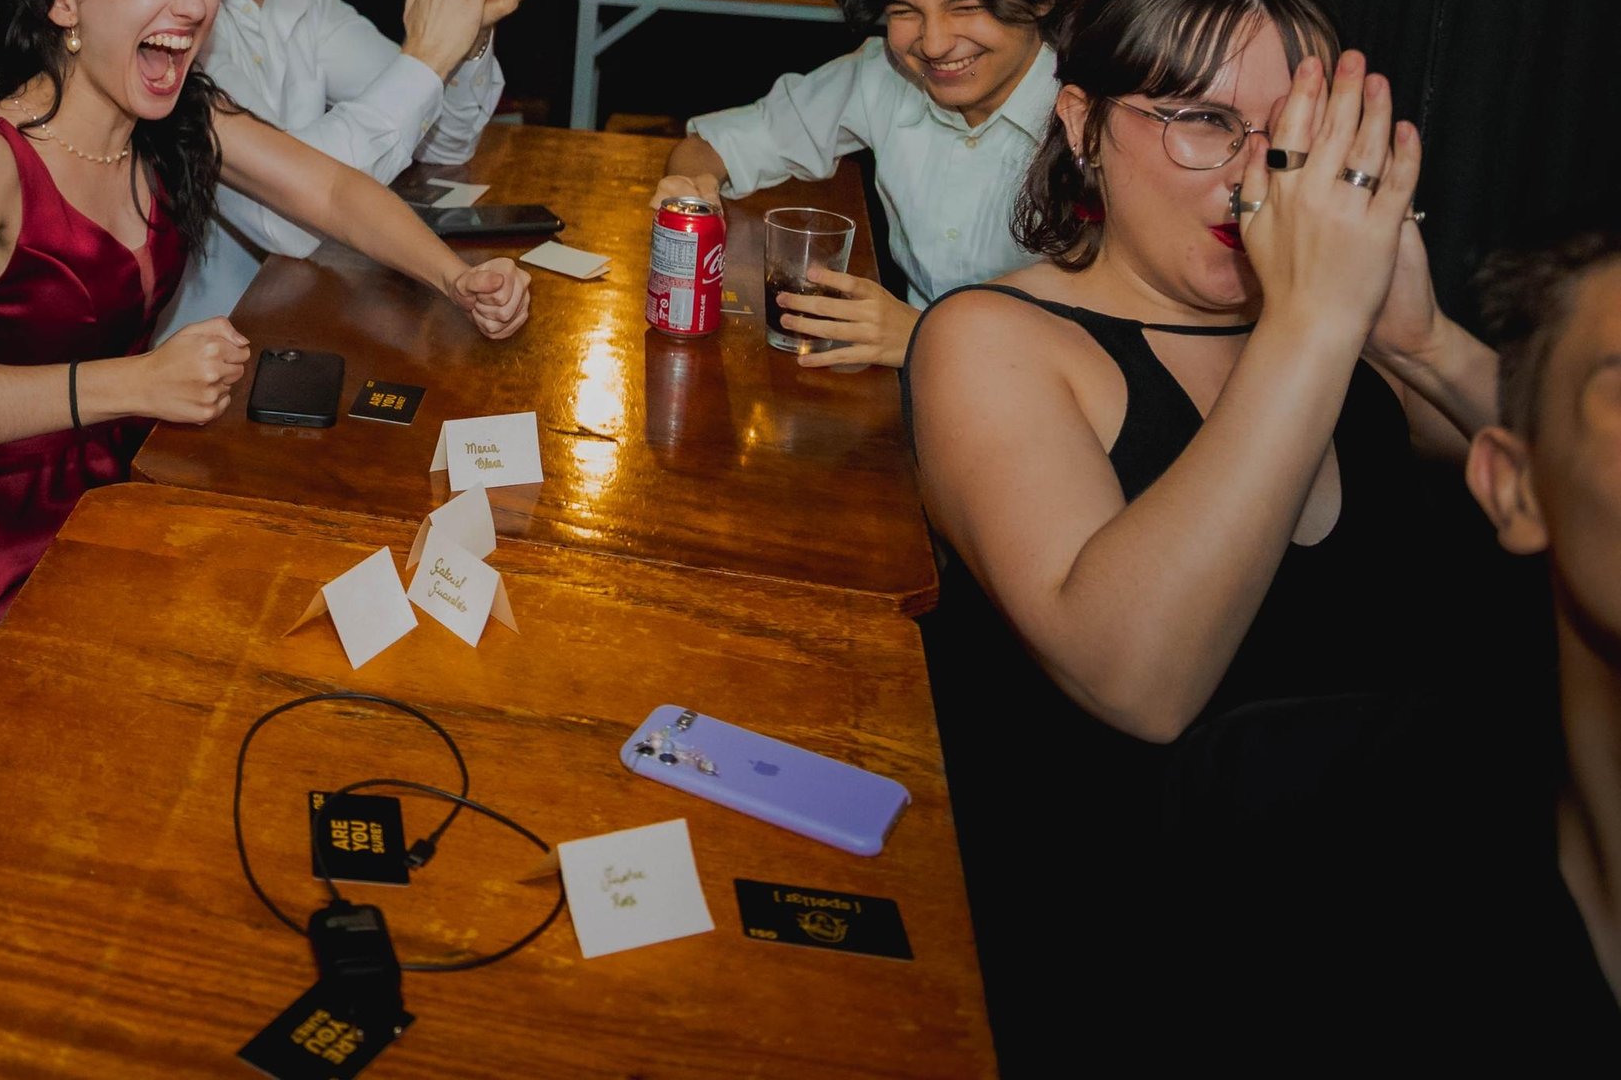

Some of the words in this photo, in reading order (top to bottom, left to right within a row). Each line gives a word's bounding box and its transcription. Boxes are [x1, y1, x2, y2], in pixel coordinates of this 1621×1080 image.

[369, 392, 384, 407] ARE
[381, 394, 397, 408] YOU
[331, 819, 351, 851] ARE
[350, 821, 370, 851] YOU
[369, 822, 385, 854] SURE?
[303, 1019, 349, 1055] YOU
